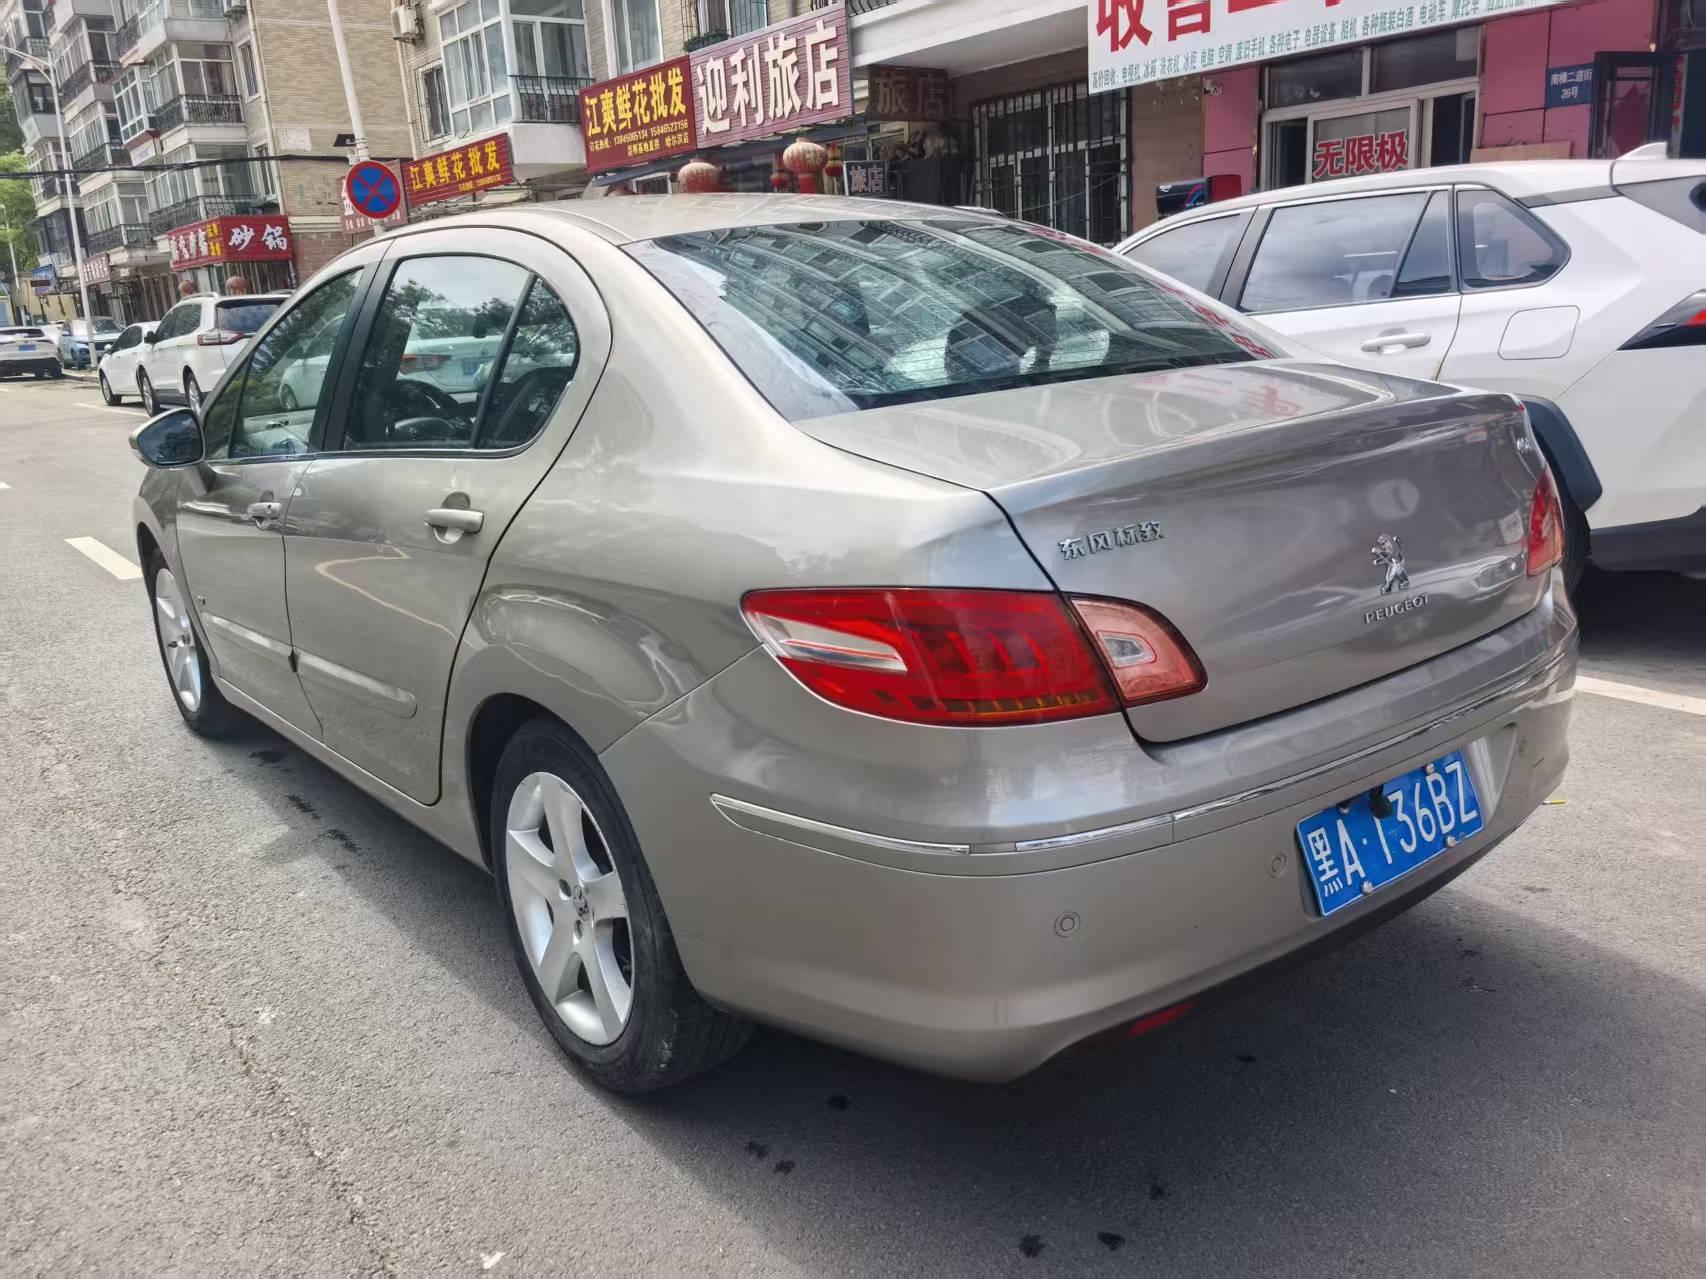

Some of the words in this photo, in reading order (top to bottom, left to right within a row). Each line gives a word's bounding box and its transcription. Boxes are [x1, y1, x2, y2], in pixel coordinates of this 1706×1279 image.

[1269, 28, 1301, 54] 各种电子
[1304, 22, 1336, 48] 电器设备
[1340, 17, 1357, 40] 相机
[1362, 6, 1414, 36] 各种瓶装白酒
[1420, 0, 1446, 25] 电动车
[696, 19, 838, 136] 迎利旅店
[876, 76, 944, 115] 旅店
[584, 66, 686, 137] 江爽鲜花批发
[410, 140, 500, 192] 江爽鲜花批发
[1313, 128, 1409, 178] 无限极
[849, 164, 884, 193] 旅店
[228, 224, 288, 251] 砂锅
[1057, 519, 1166, 561] 东风标致
[1363, 592, 1431, 625] PEUGEOT
